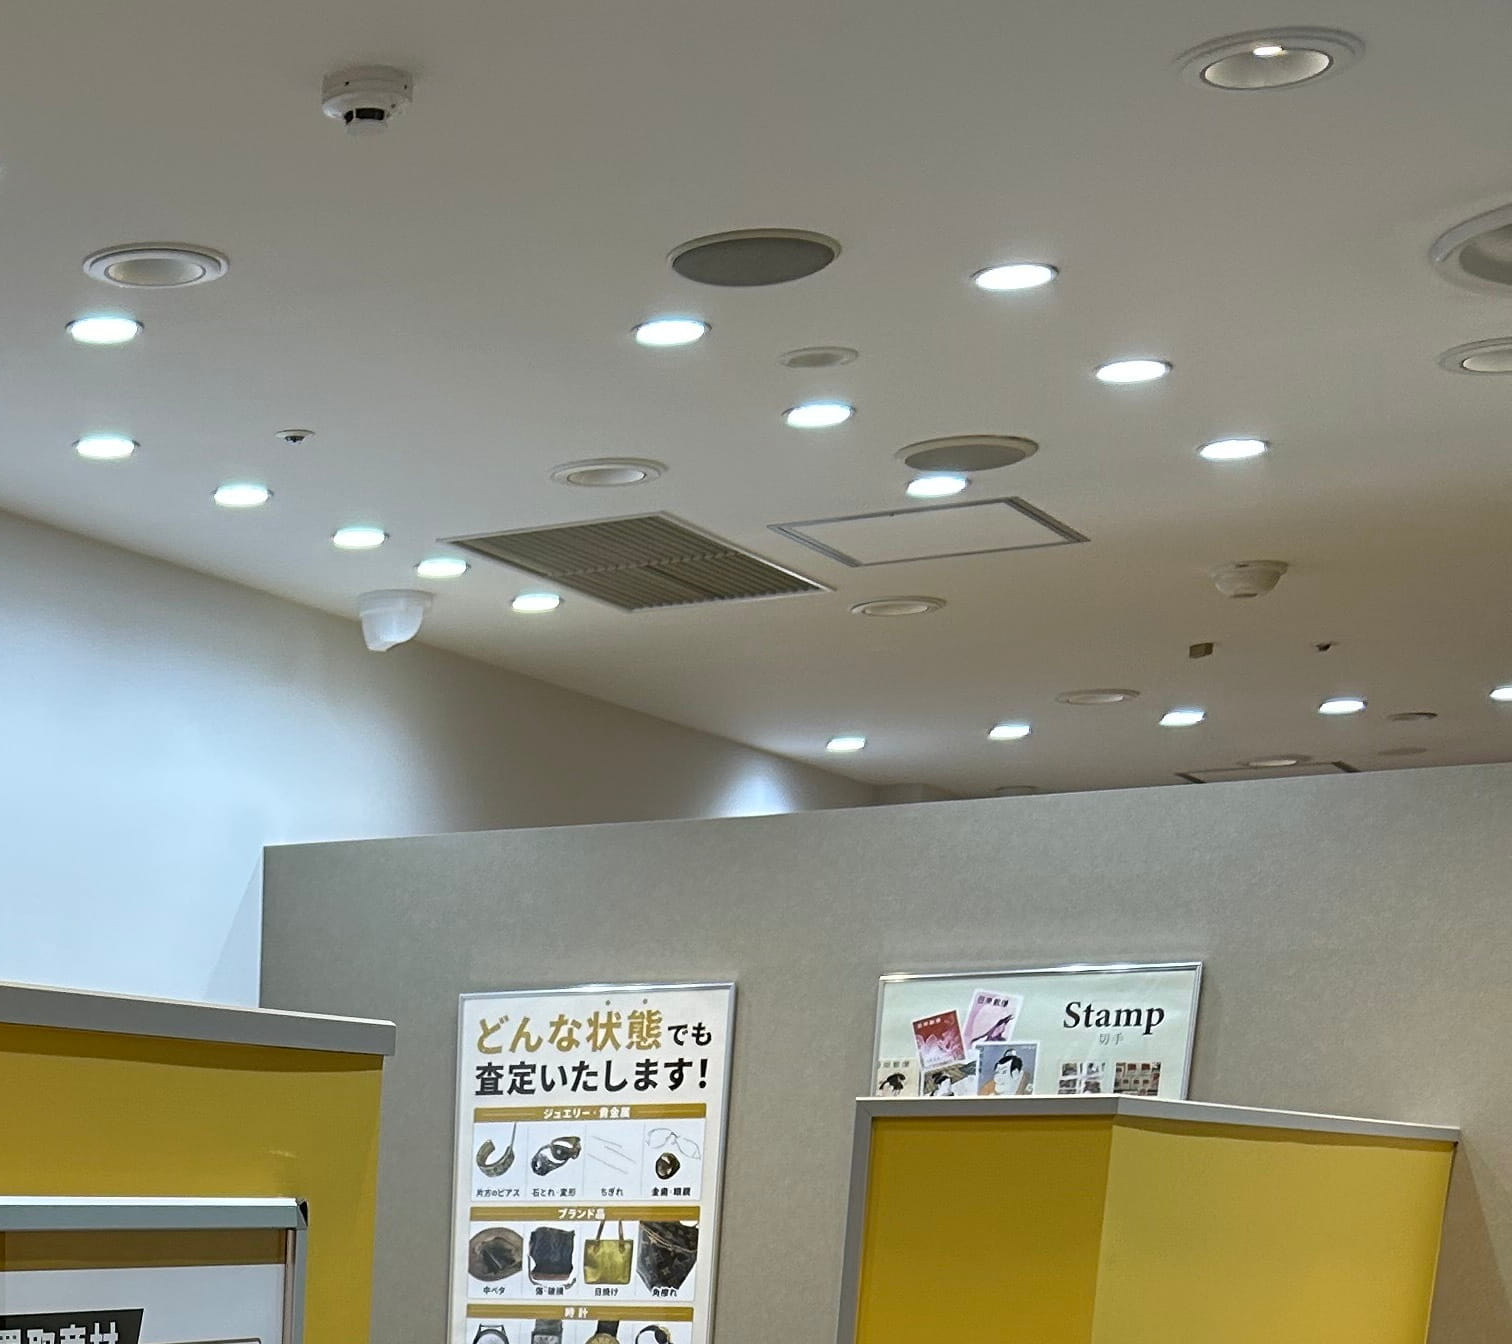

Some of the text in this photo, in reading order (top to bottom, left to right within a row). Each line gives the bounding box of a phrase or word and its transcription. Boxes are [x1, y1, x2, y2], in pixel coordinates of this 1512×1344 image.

[476, 1009, 713, 1055] どんな状態でも
[1063, 1000, 1166, 1036] Stamp
[474, 1057, 709, 1097] 査定いたします!
